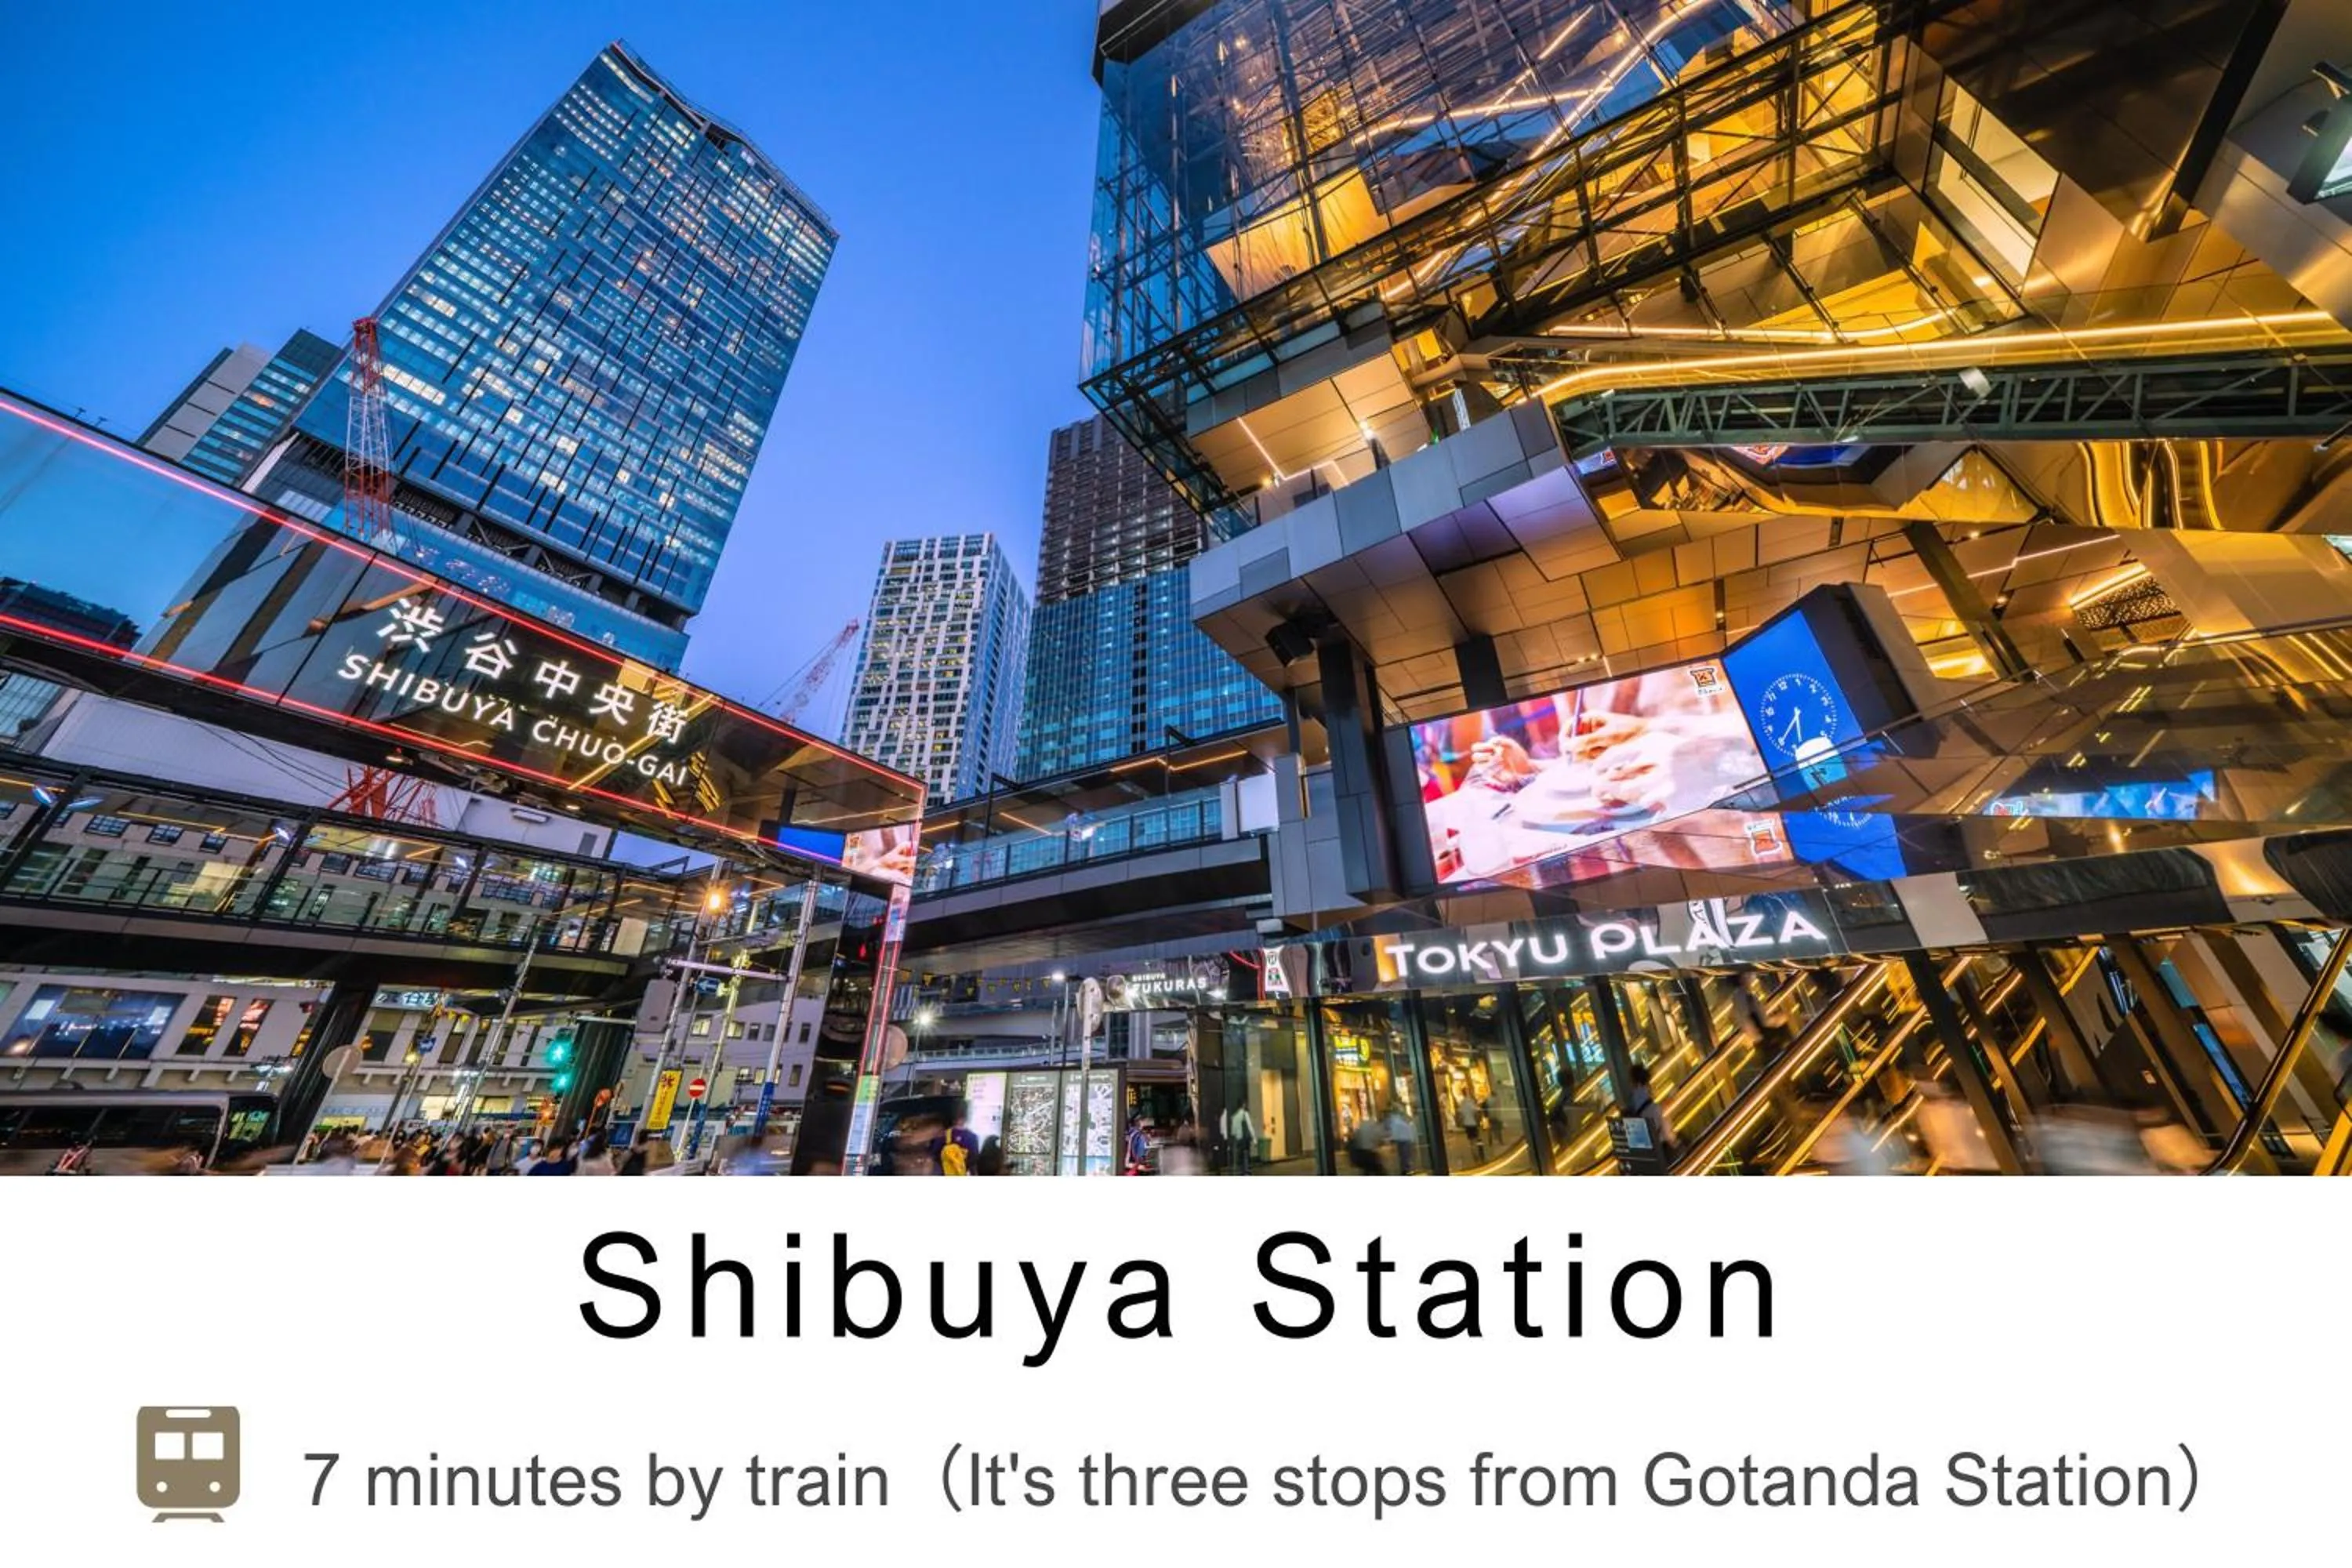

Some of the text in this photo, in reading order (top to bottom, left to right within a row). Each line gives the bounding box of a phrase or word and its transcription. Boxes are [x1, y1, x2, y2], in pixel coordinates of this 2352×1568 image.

[337, 653, 688, 787] SHIBUYA CHUO-GAI
[375, 597, 688, 745] 渋谷中央街
[1385, 909, 1828, 977] TOKYU PLAZA
